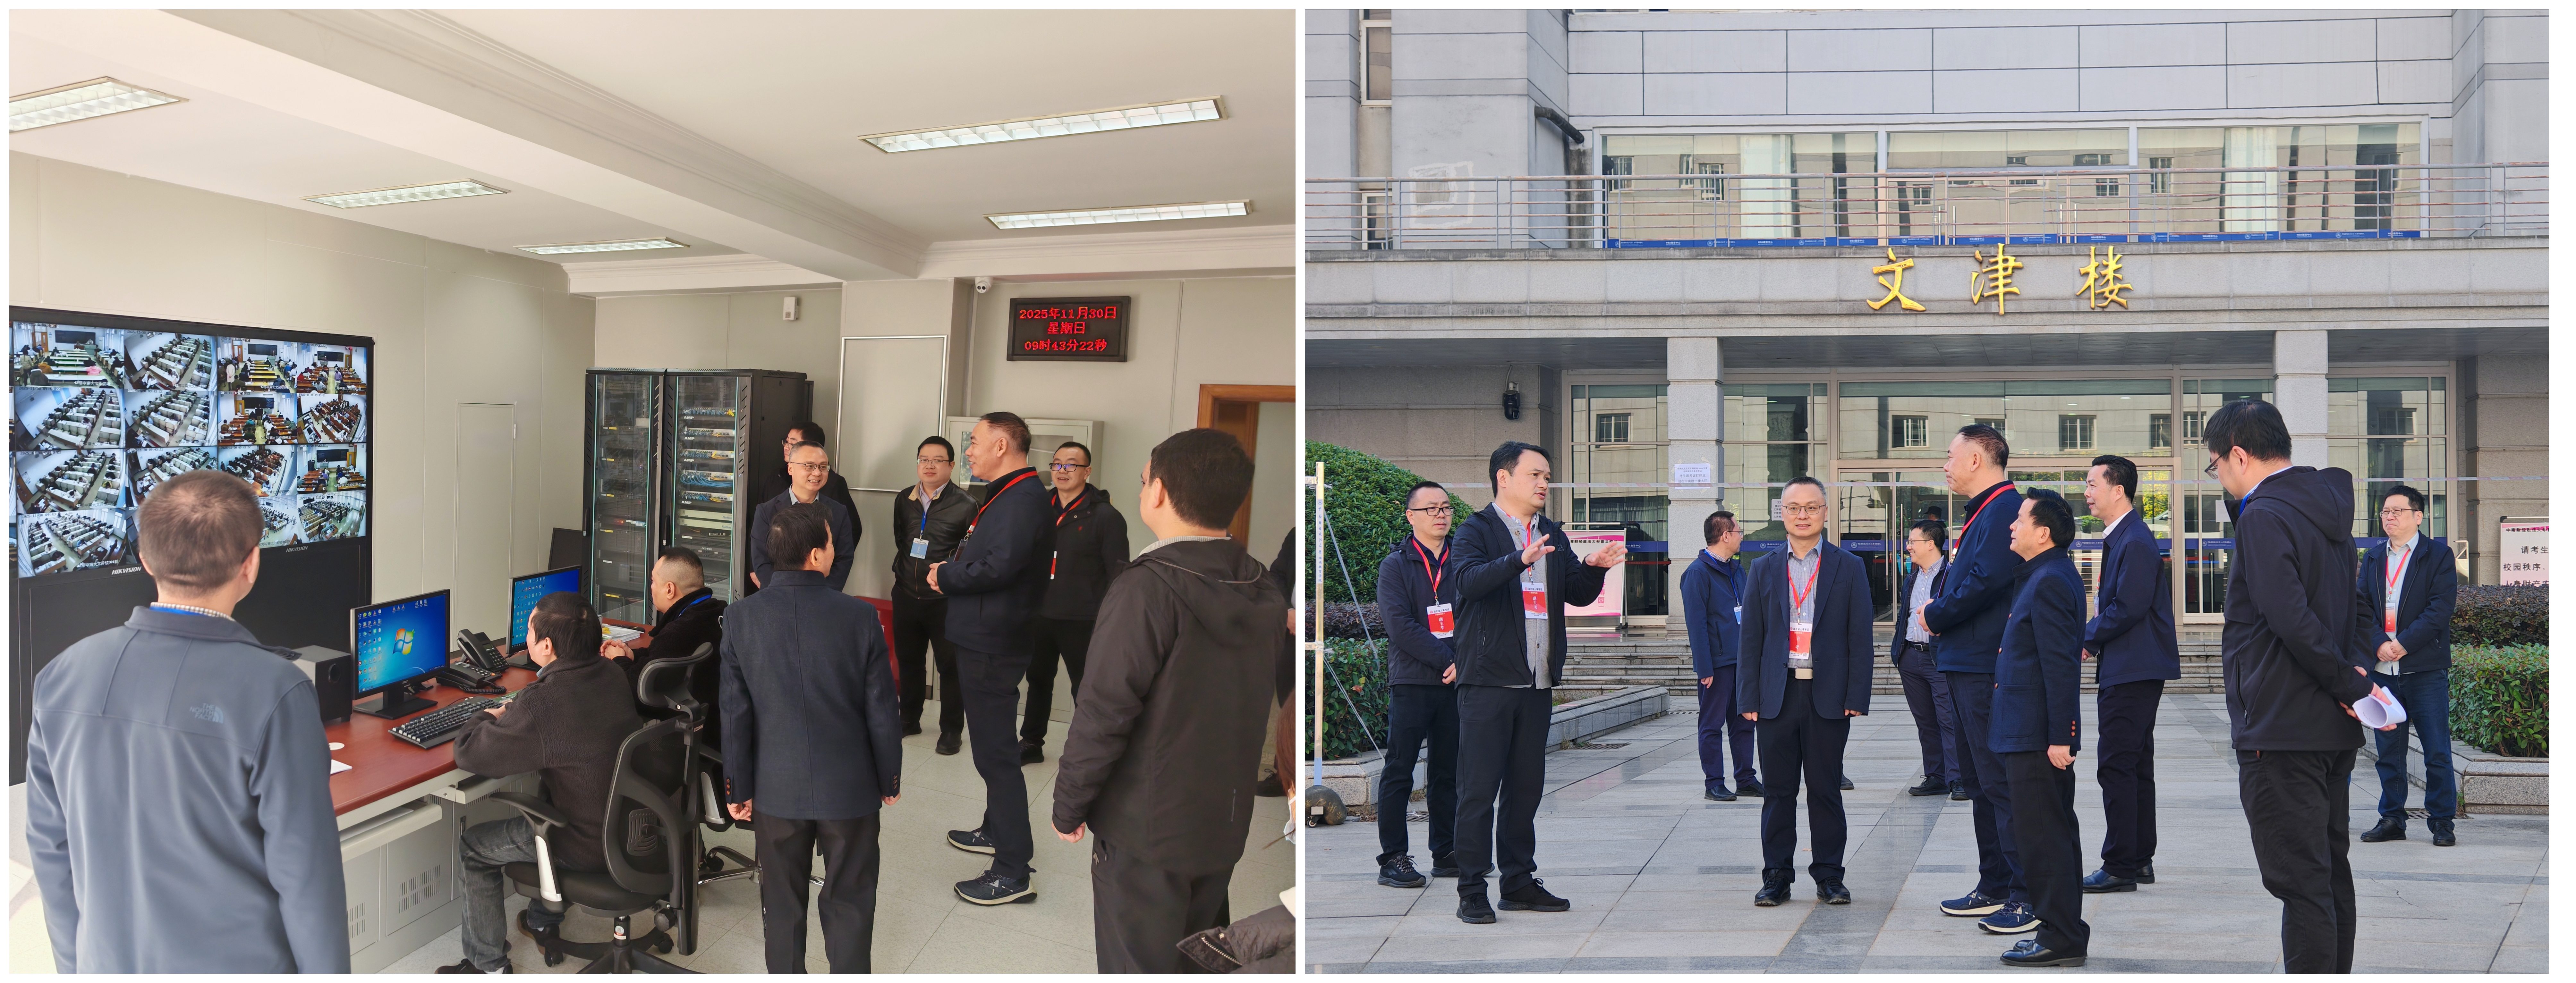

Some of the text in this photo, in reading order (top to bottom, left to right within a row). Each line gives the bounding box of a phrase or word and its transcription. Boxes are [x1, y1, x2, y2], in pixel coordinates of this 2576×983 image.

[1866, 243, 2134, 315] 文津楼
[1020, 306, 1116, 319] 2025年11月30日
[1047, 322, 1085, 334] 星期日
[1025, 339, 1107, 351] 09时43分22秒
[2521, 546, 2549, 554] 请考生
[111, 566, 142, 575] HIKVISION
[194, 713, 212, 721] FACE
